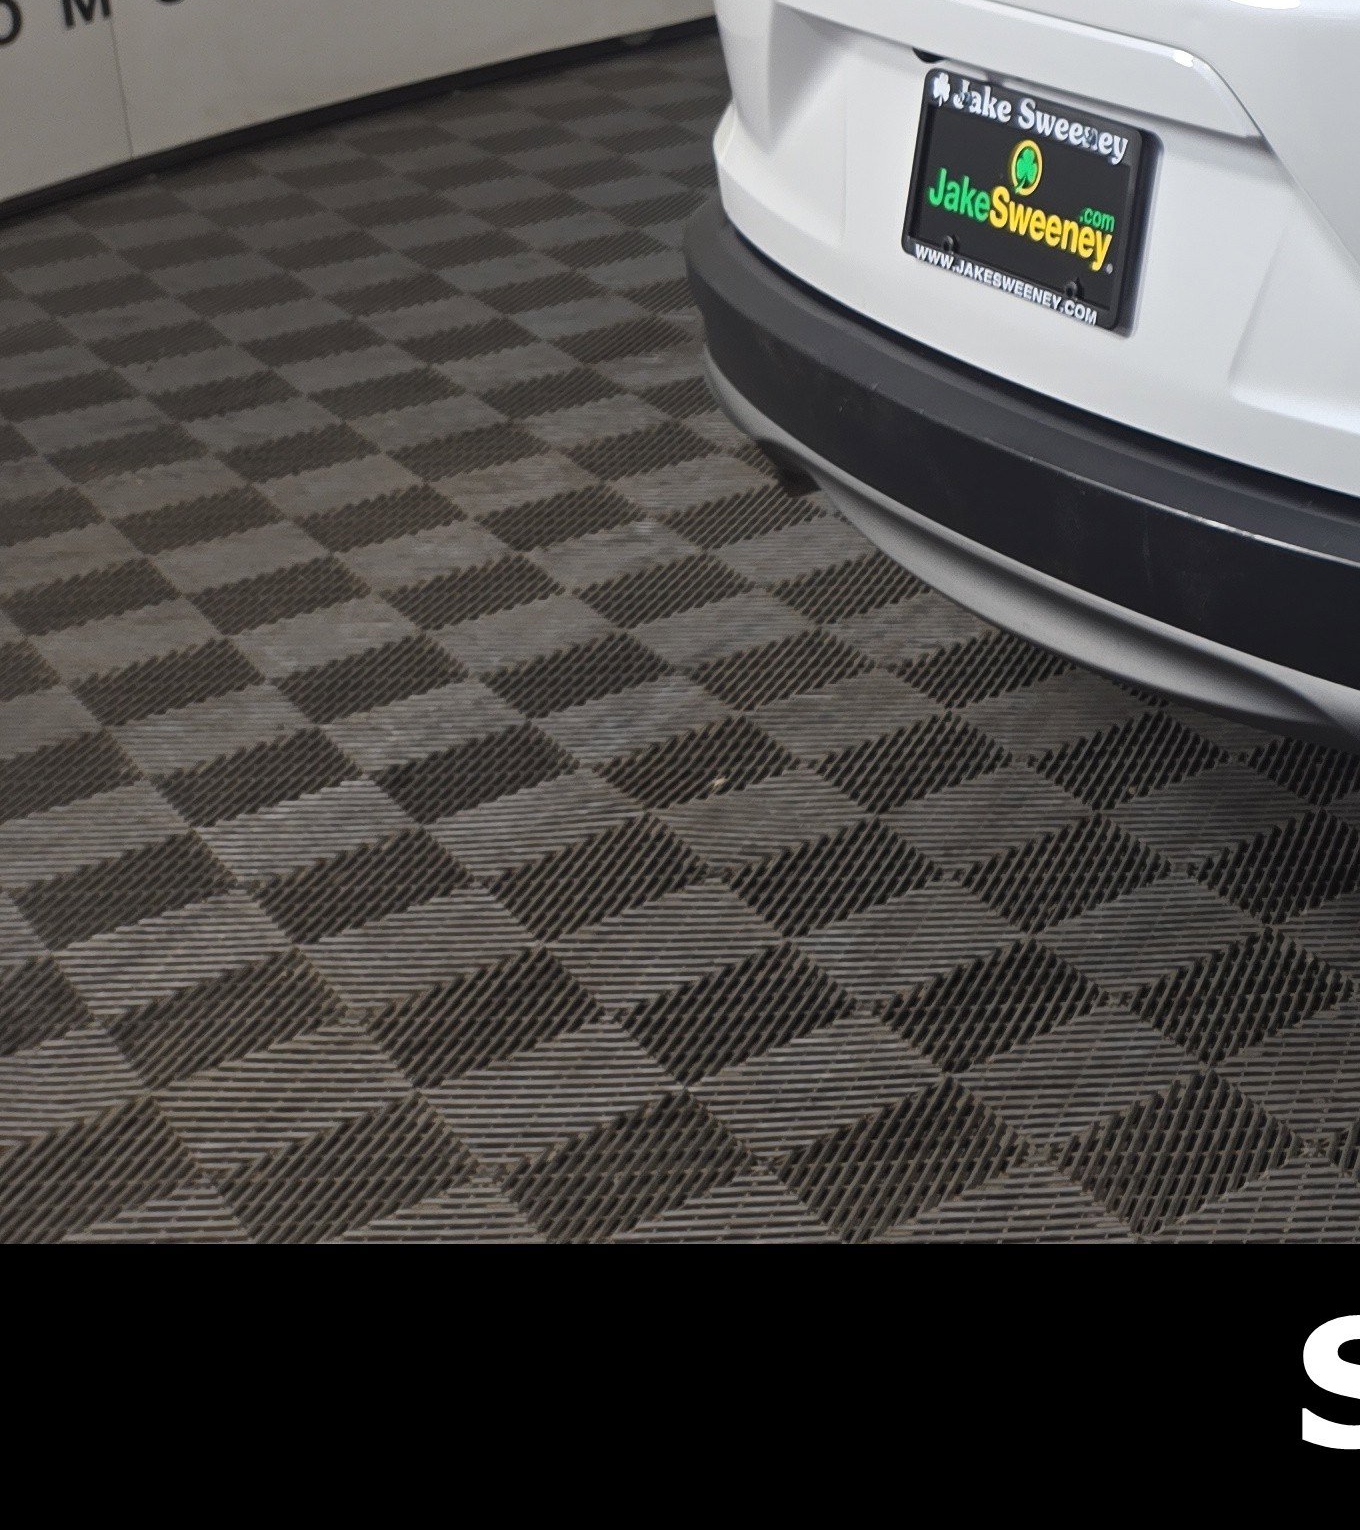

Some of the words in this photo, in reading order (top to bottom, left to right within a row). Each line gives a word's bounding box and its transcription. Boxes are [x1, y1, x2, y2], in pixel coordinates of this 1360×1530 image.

[953, 79, 1012, 123] Jake
[1017, 97, 1129, 166] Sweeney
[914, 242, 1098, 327] WWW.JAKESWEENEY.COM
